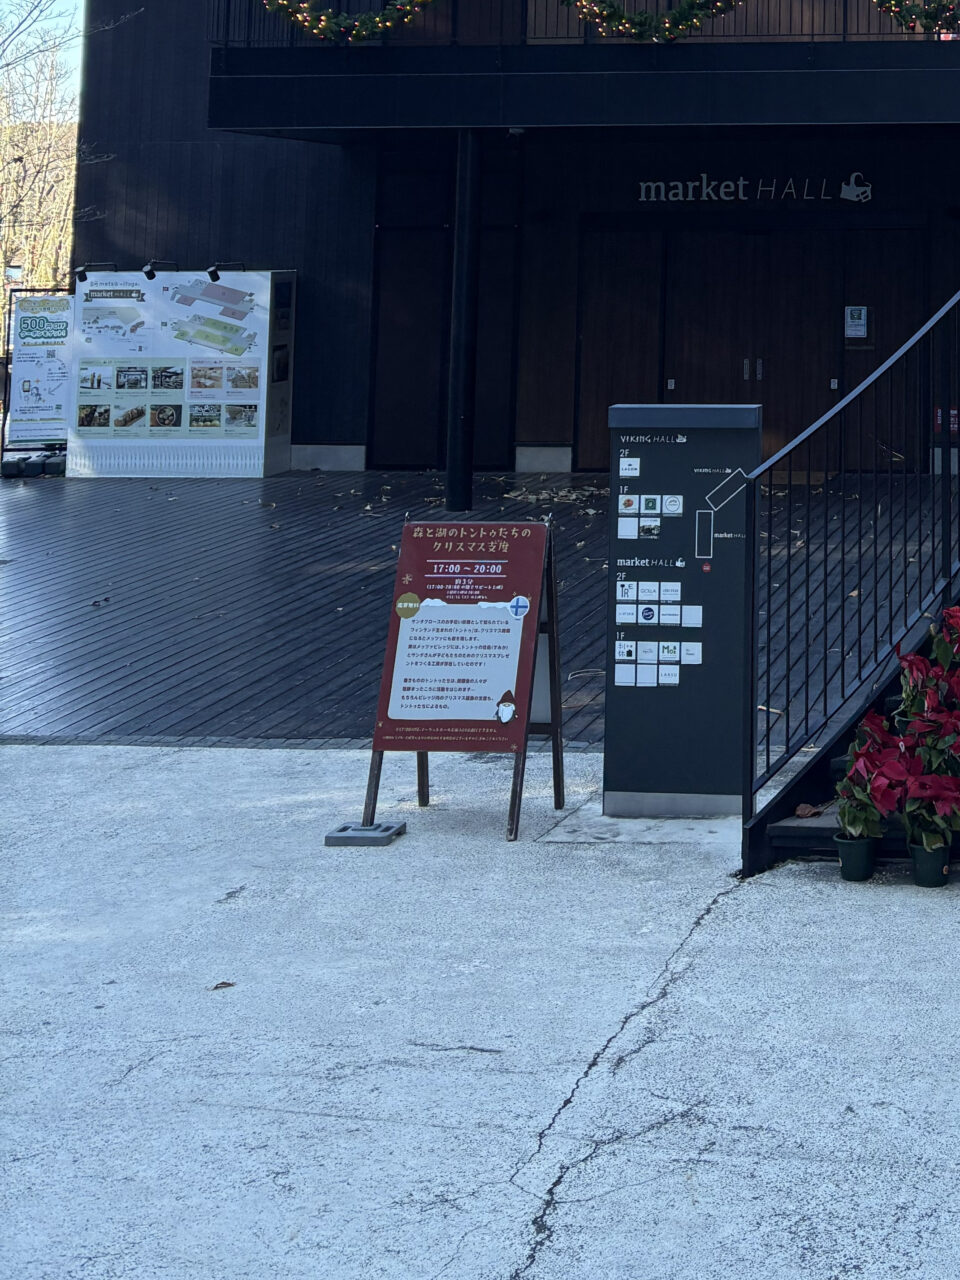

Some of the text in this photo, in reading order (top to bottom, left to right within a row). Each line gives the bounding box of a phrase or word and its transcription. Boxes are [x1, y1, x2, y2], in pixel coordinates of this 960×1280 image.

[638, 173, 832, 202] market HALL
[620, 434, 675, 443] VIKING HALL
[619, 449, 630, 458] 2F
[619, 486, 629, 494] 1F
[413, 527, 531, 538] 森と湖のトントゥたちの
[433, 542, 510, 553] クリスマス支度
[617, 557, 674, 567] market HALL
[433, 564, 460, 573] 17:00
[473, 564, 502, 573] 20:00
[616, 572, 627, 581] 2F
[616, 631, 625, 640] 1F
